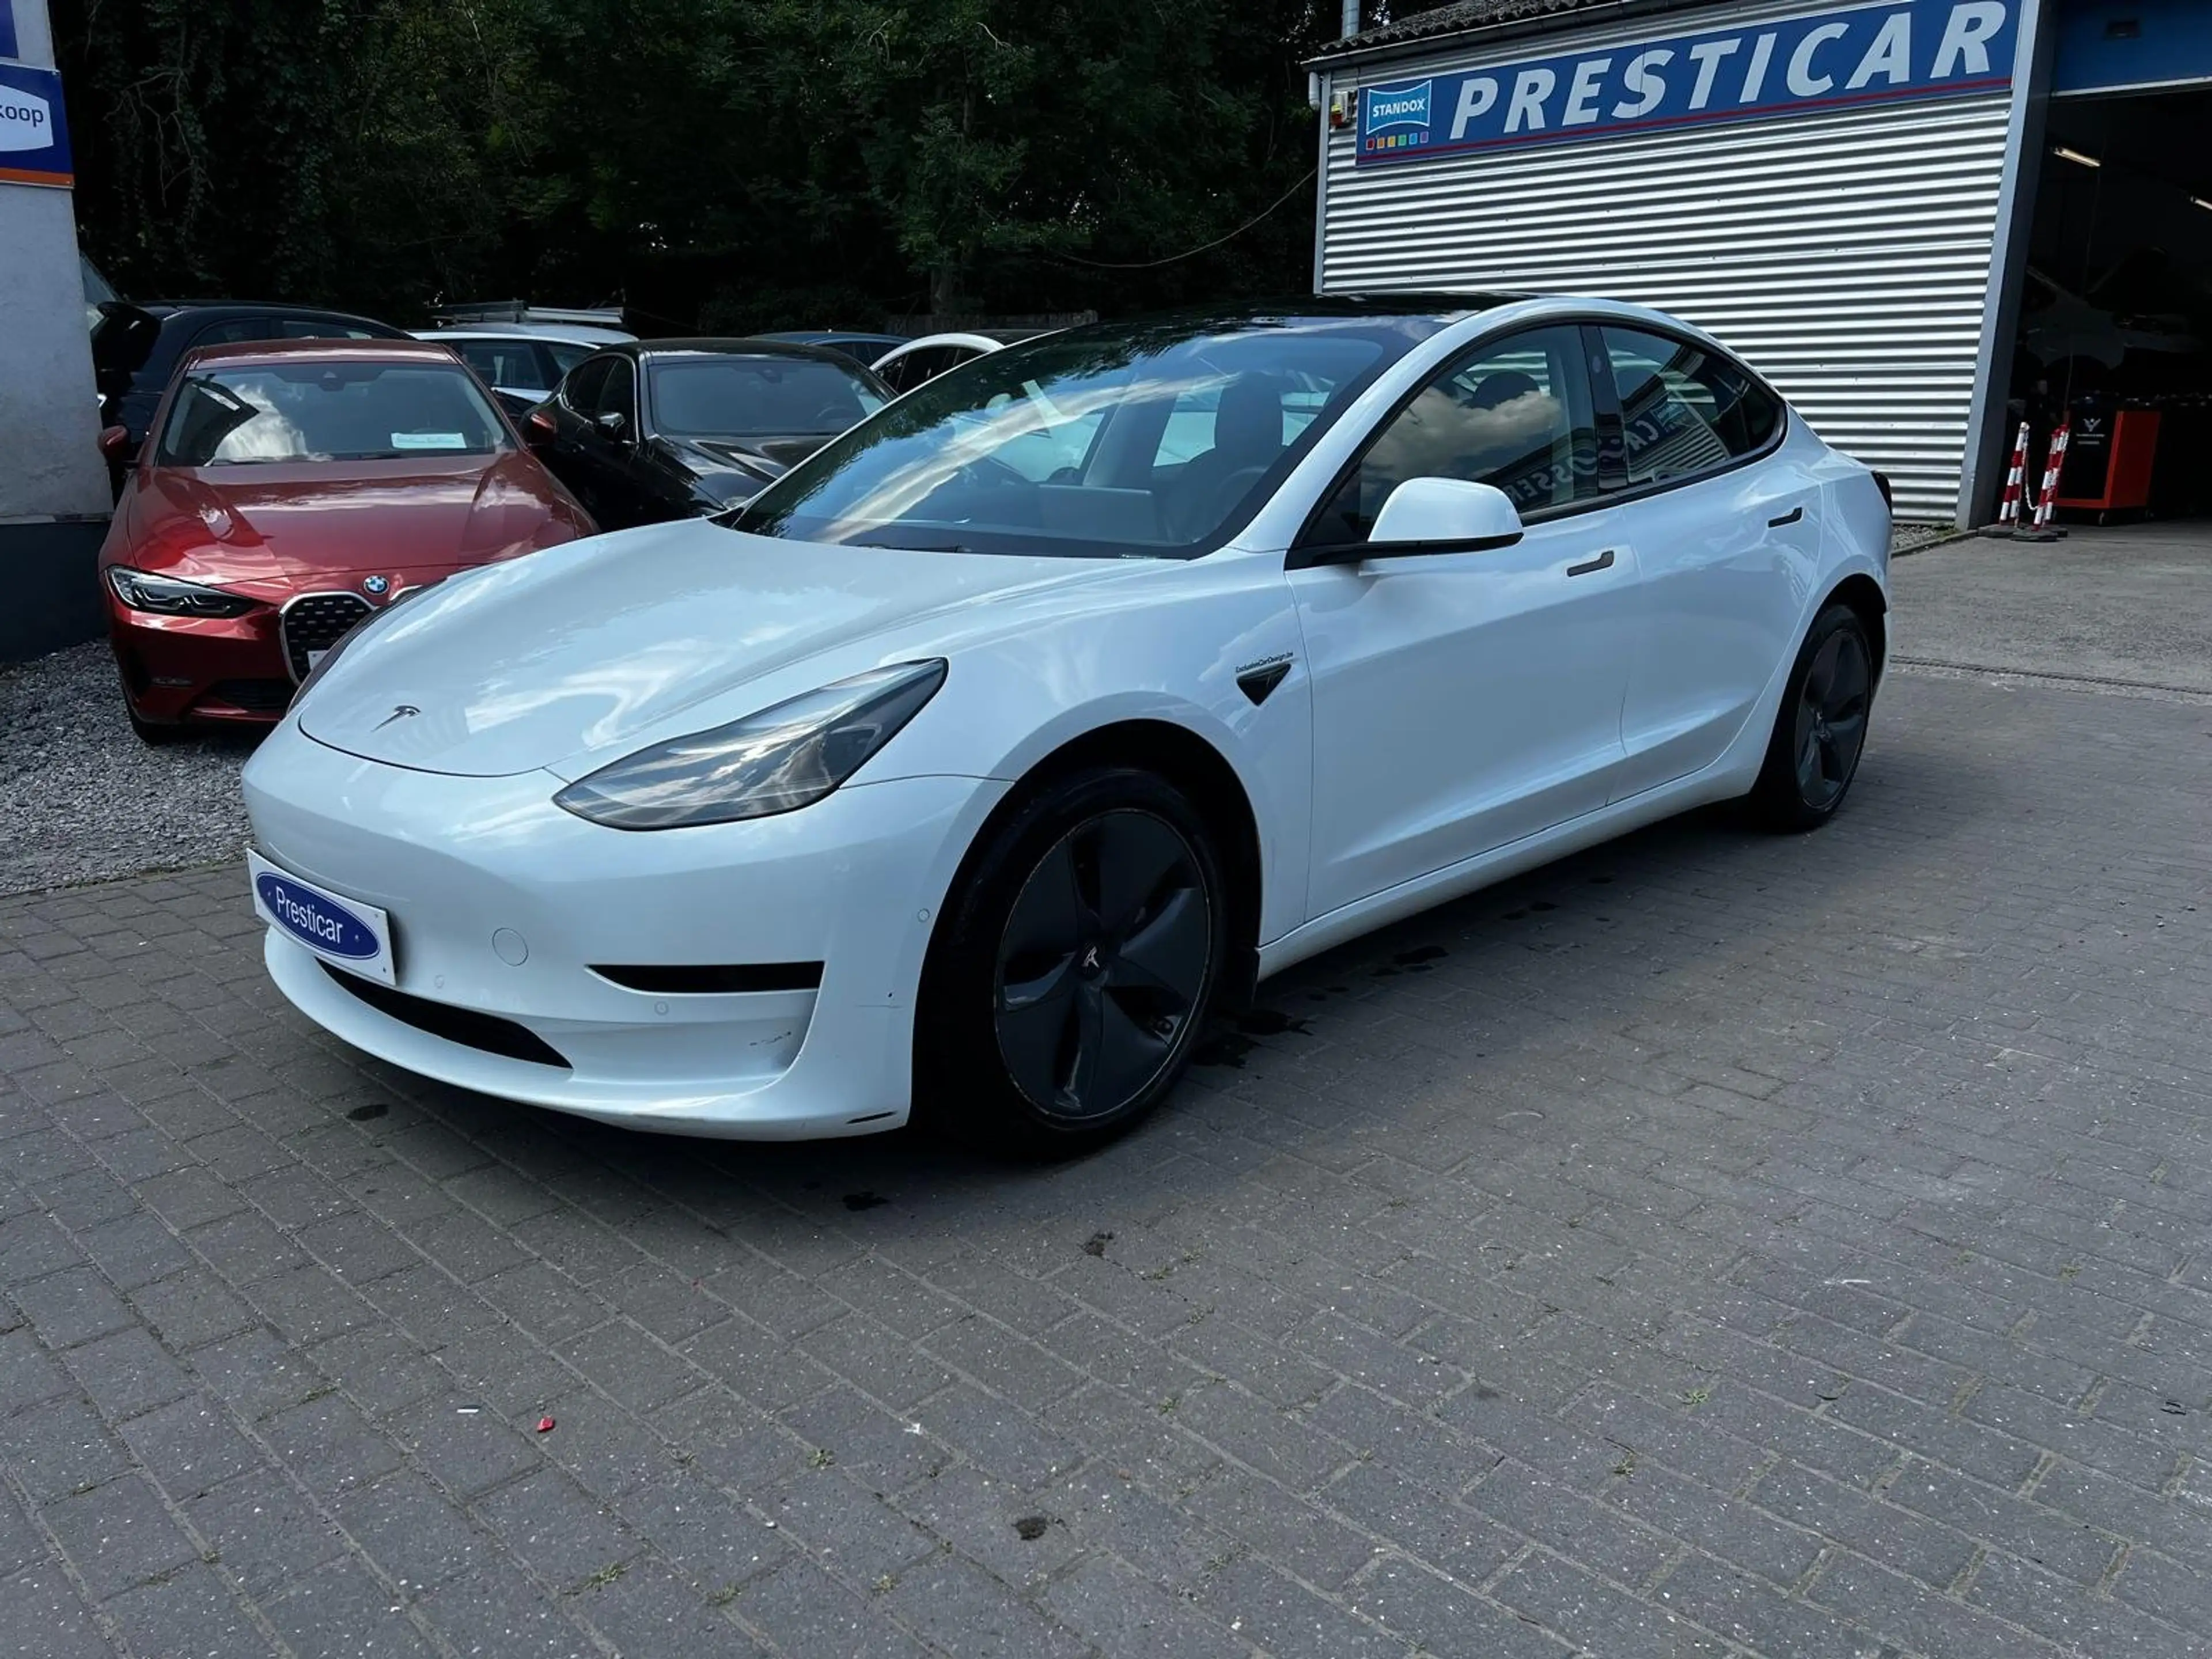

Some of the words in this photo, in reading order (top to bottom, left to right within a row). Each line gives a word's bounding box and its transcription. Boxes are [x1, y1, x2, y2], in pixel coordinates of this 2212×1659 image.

[1449, 1, 2006, 139] PRESTICAR
[1372, 98, 1426, 118] STANDOX
[276, 885, 343, 944] Presticar
